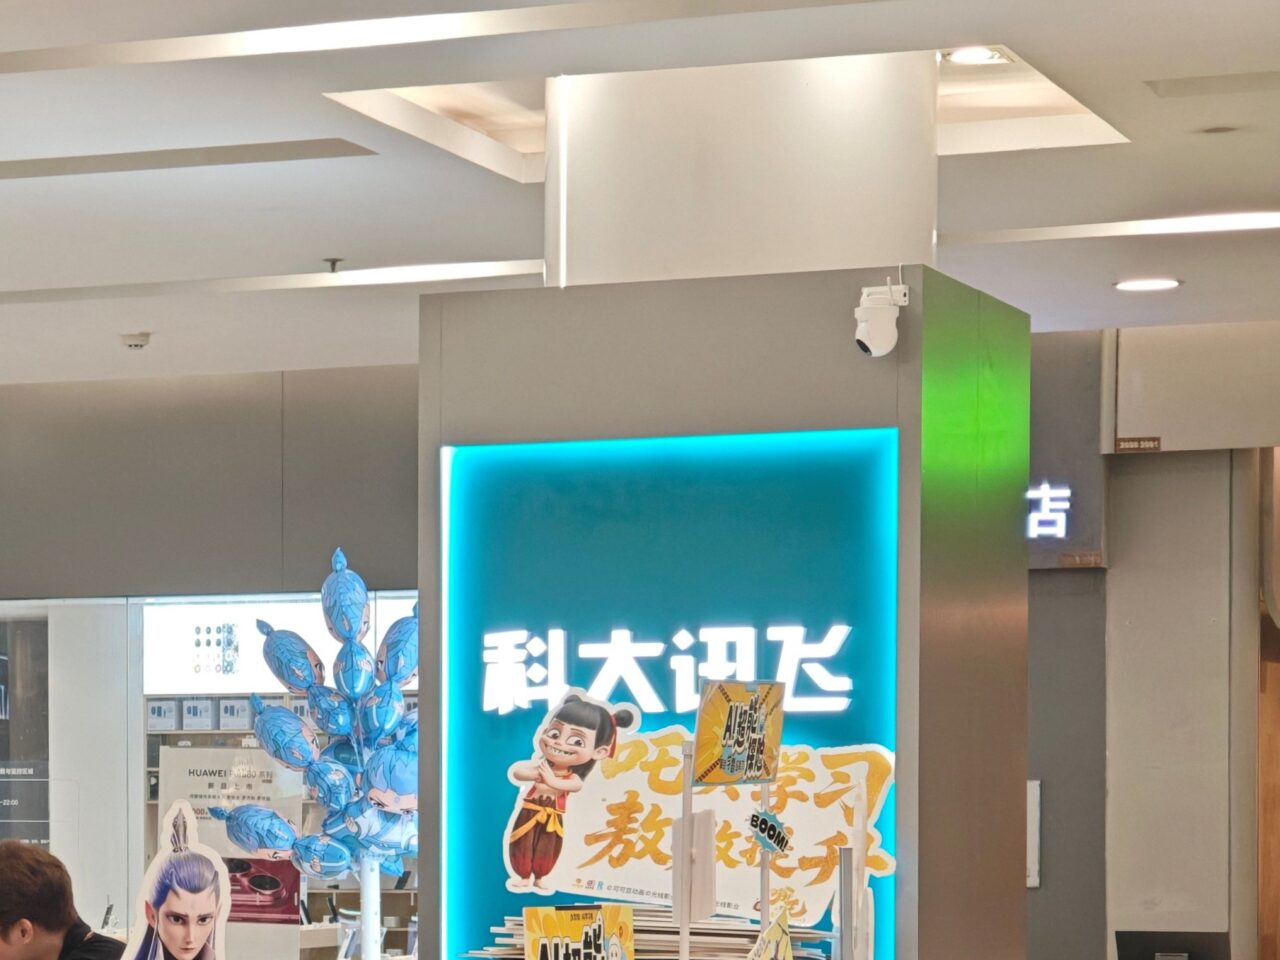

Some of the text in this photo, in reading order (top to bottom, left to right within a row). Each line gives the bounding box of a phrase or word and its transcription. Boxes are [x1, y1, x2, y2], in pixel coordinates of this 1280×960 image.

[483, 625, 853, 714] 科大讯飞
[189, 769, 226, 778] HUAWEI
[601, 732, 892, 826] 吒学习
[751, 813, 788, 852] BOOM!
